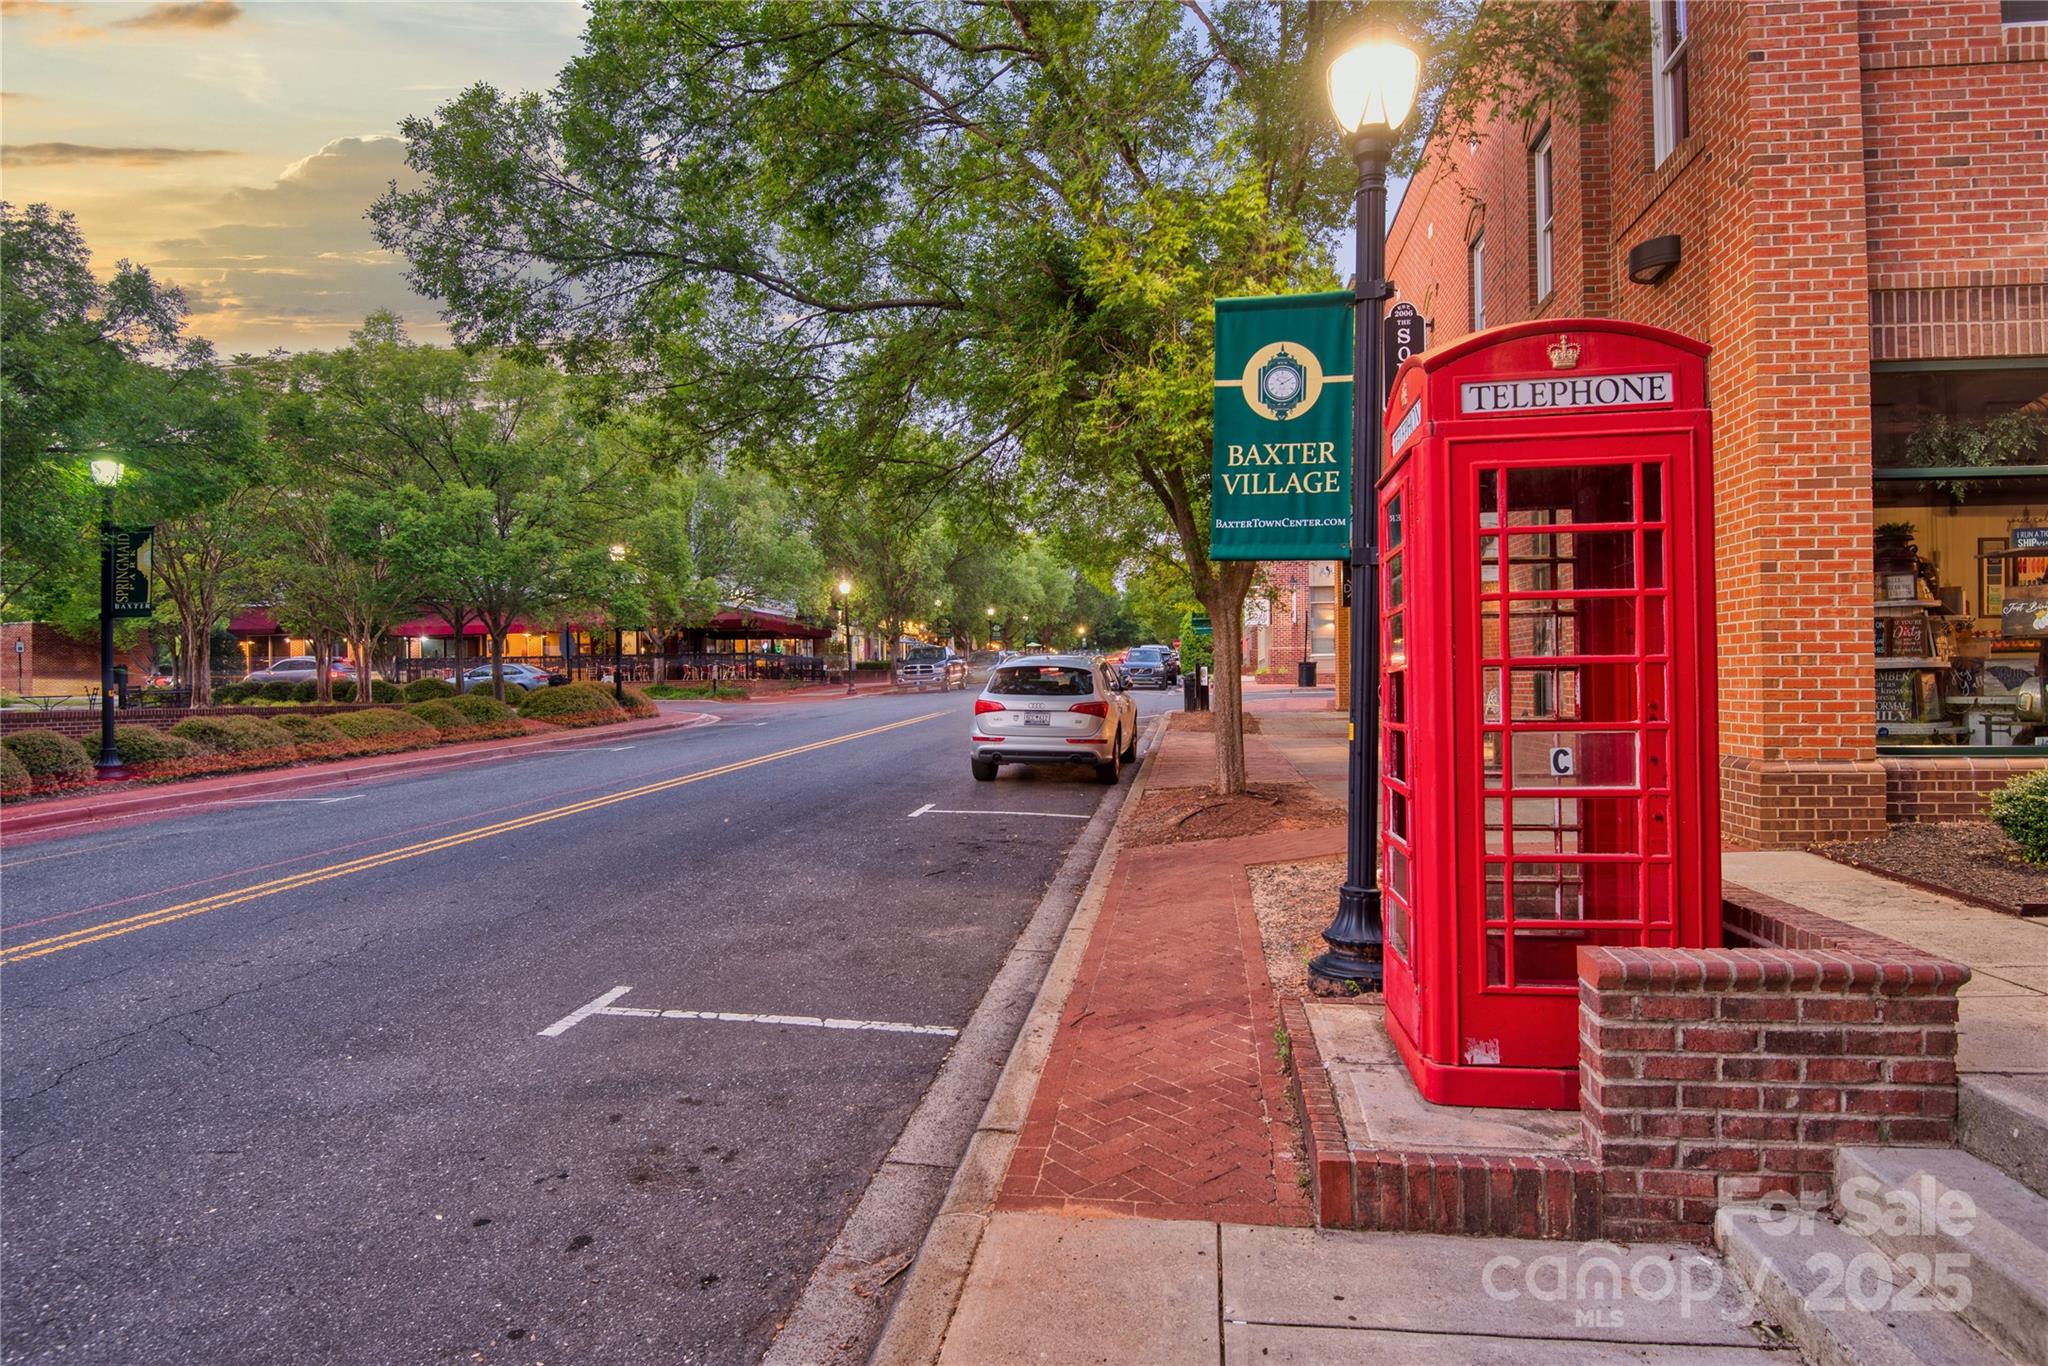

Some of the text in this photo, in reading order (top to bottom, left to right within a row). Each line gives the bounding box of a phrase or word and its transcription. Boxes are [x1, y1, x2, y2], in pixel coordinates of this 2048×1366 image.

[1469, 376, 1667, 410] TELEPHONE
[1227, 441, 1337, 467] BAXTER
[1221, 471, 1340, 496] VILLAGE
[2017, 538, 2037, 547] SHIP
[115, 533, 130, 603] SPRINGMAID
[1552, 749, 1570, 774] C
